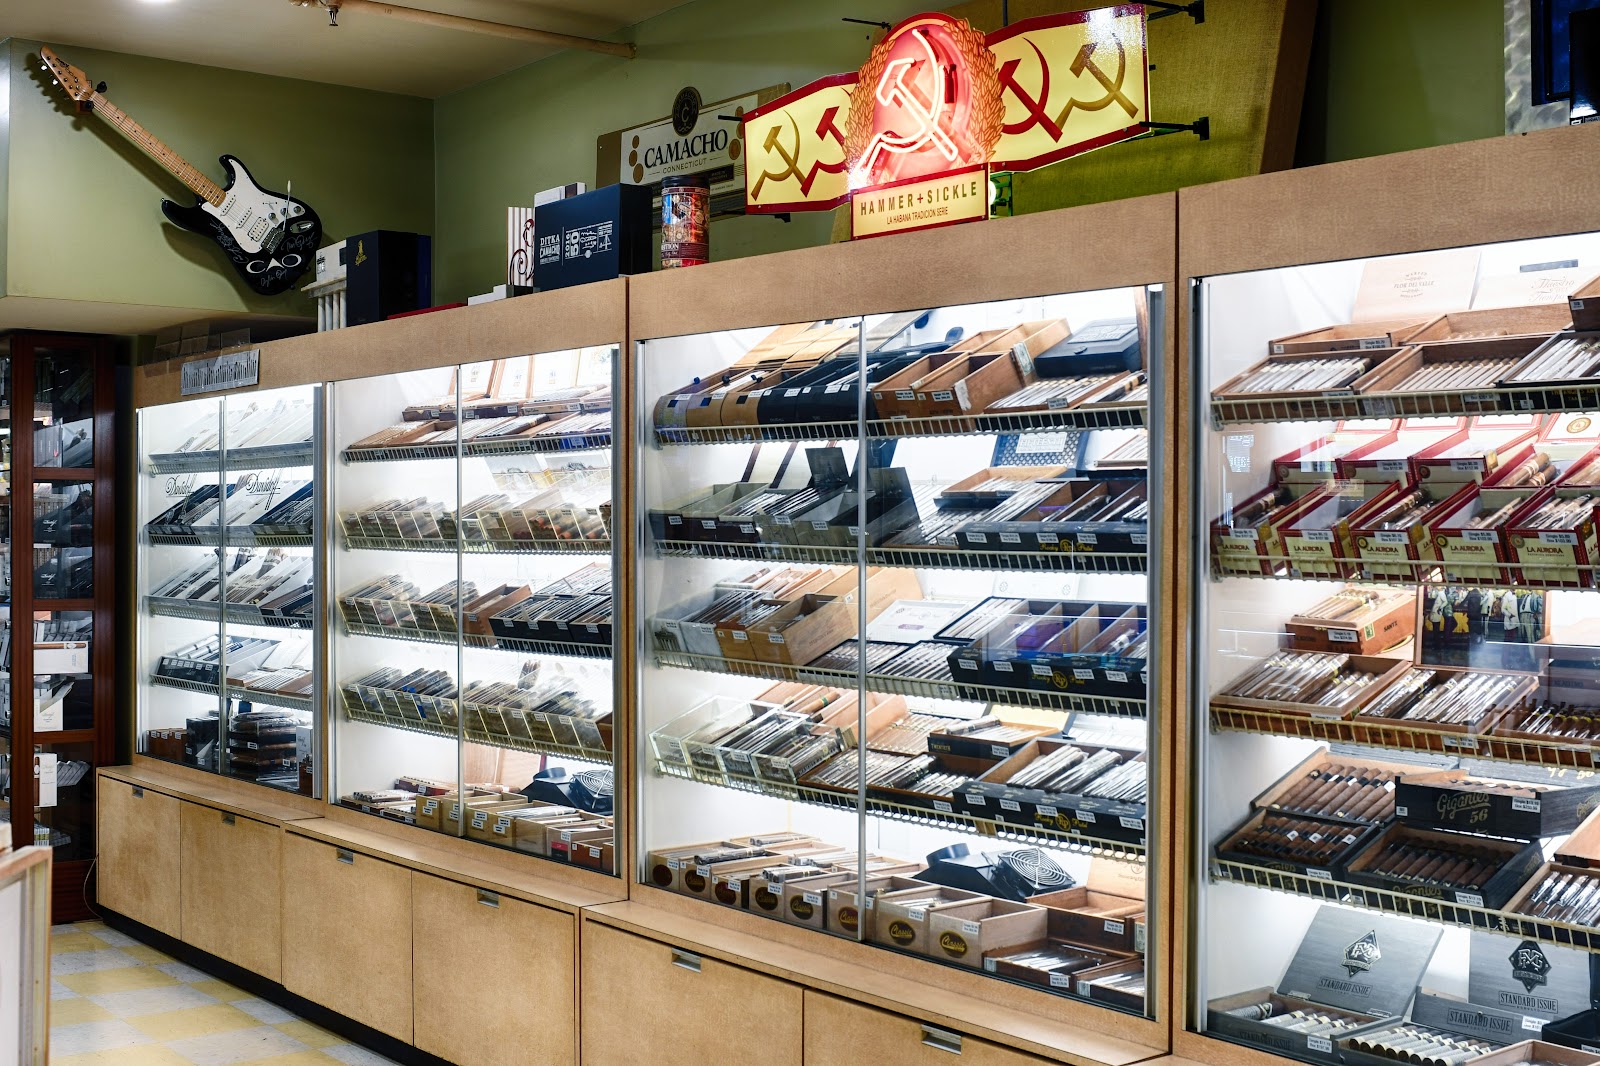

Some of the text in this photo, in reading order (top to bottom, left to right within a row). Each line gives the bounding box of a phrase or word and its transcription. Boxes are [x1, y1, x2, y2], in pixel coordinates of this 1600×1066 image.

[644, 129, 728, 168] CAMACHO
[662, 158, 707, 174] CONNECTICUT
[886, 216, 893, 225] LA
[894, 212, 912, 223] HABANA
[936, 206, 948, 216] SERIE
[540, 234, 560, 246] DITKA
[1436, 791, 1490, 820] Gigantes
[1470, 809, 1488, 824] 56
[891, 924, 912, 938] Classic
[942, 936, 965, 952] Classic
[1319, 978, 1352, 991] STANDARD
[1351, 984, 1370, 994] ISSUE
[1500, 993, 1557, 1011] STANDARD ISSUE
[1449, 1011, 1511, 1031] STANDARD ISSUE
